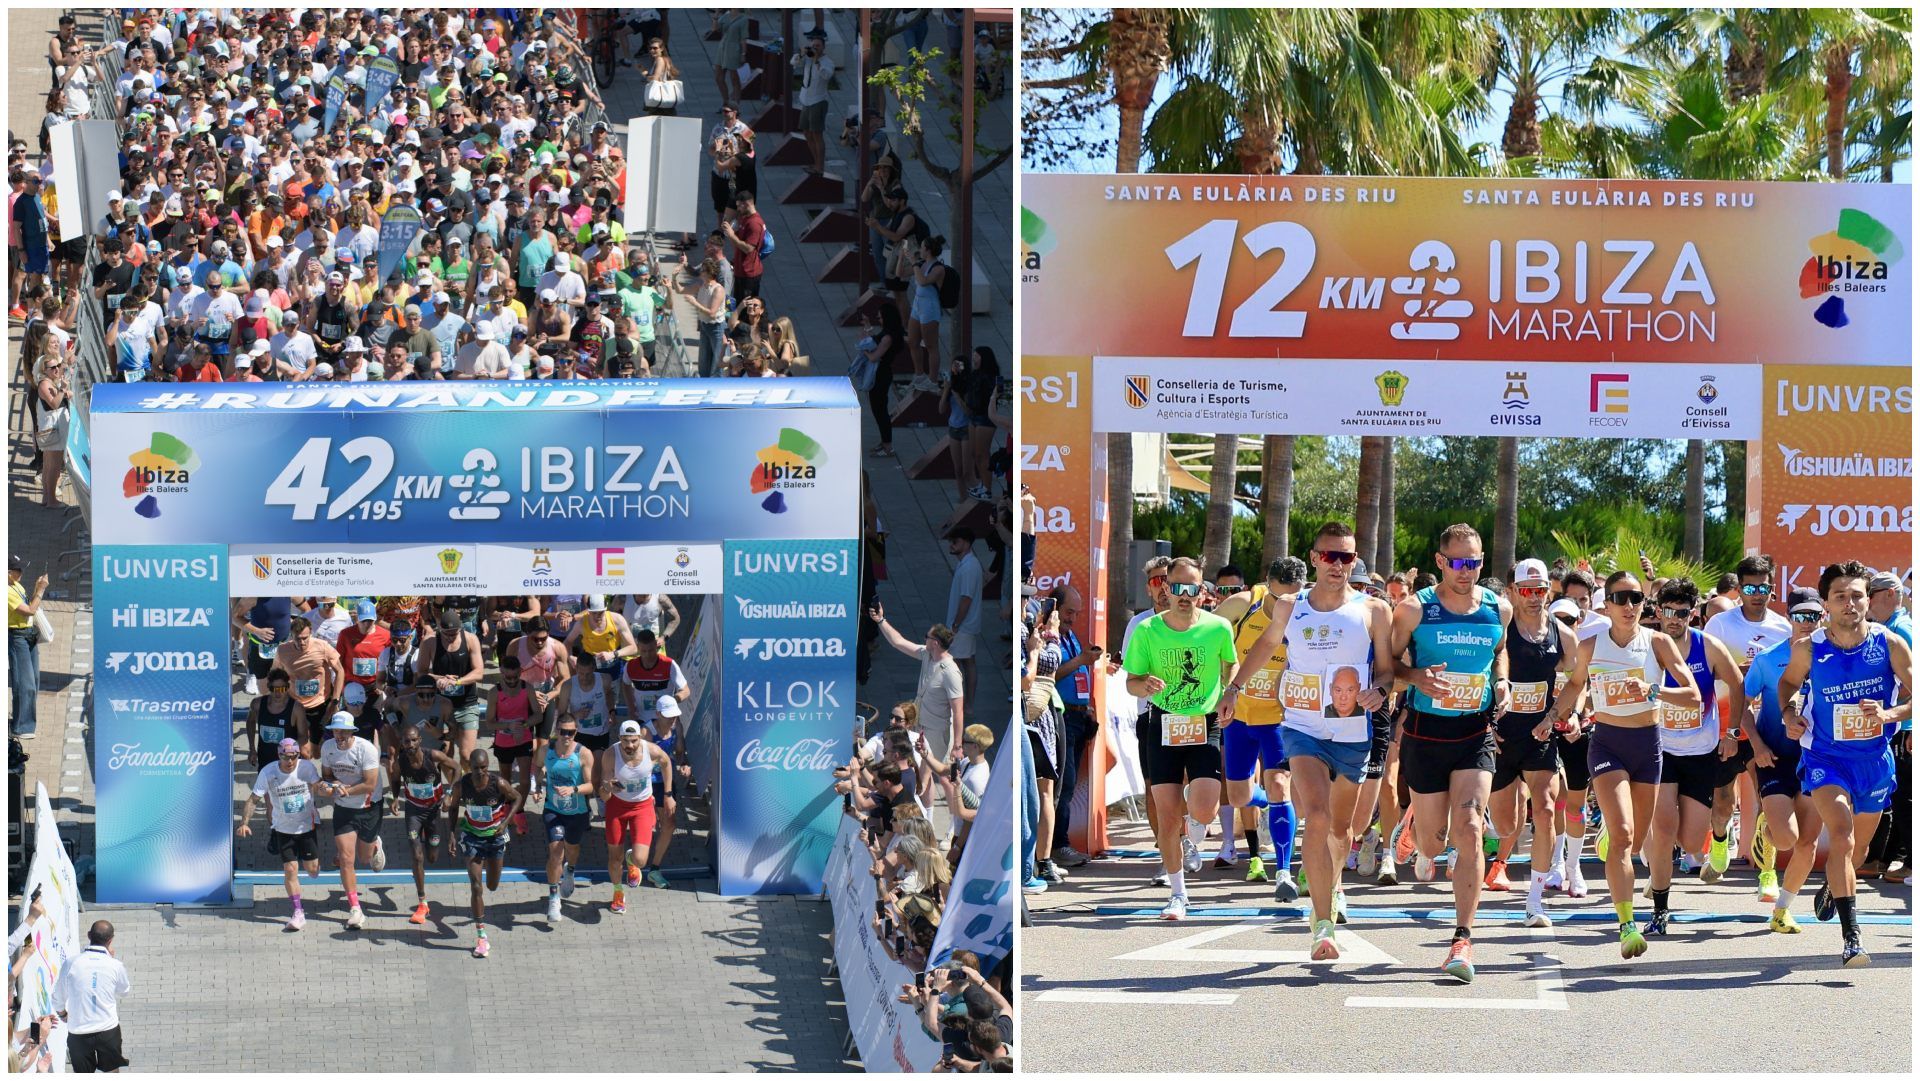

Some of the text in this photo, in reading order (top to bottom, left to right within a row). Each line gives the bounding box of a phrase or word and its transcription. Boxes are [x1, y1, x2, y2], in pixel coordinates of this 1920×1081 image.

[367, 70, 392, 86] 3:45
[1105, 181, 1397, 204] SANTA EULÀRIA DES RIU
[1463, 187, 1755, 208] SANTA EULÀRIA DES RIU
[381, 224, 414, 239] 3:15
[1488, 239, 1717, 306] IBIZA
[1817, 254, 1888, 280] Ibiza
[1164, 219, 1387, 338] 12 KM
[1817, 281, 1887, 293] Illes Balears
[1487, 308, 1717, 343] MARATHON
[1156, 378, 1288, 394] Conselleria de Turisme,
[138, 388, 810, 409] #RUNANDFEEL
[1156, 392, 1197, 405] Cultura
[1208, 394, 1251, 407] Esports
[1686, 405, 1728, 417] Consell
[1341, 418, 1369, 426] SANTA
[1490, 412, 1542, 427] eivissa
[1589, 417, 1629, 427] FECOEV
[1681, 417, 1730, 429] d'Eivissa
[136, 466, 190, 484] Ibiza
[521, 445, 689, 493] IBIZA
[764, 461, 817, 480] Ibiza
[264, 436, 443, 521] 42 KM
[764, 481, 815, 489] Illes Balears
[136, 485, 189, 494] Illes Balears
[521, 494, 690, 519] MARATHON
[103, 554, 219, 582] [UNVRS]
[276, 557, 373, 566] Conselleria de Turisme,
[734, 549, 848, 576] [UNVRS]
[276, 568, 306, 576] Cultura
[314, 568, 346, 577] Esports
[523, 578, 561, 587] eivissa
[664, 578, 701, 586] d'Eivissa
[112, 603, 139, 628] HÏ
[743, 600, 847, 619] USHUAÏA IBIZA
[1436, 630, 1493, 647] Escaladores
[1247, 677, 1276, 691] 506
[1822, 676, 1884, 695] CLUB ATLETISMO
[737, 680, 841, 709] KLOK
[1286, 684, 1319, 701] 5000
[1448, 685, 1482, 700] 5020
[1514, 691, 1545, 704] 5067
[130, 696, 216, 713] Trasmed
[745, 711, 834, 722] LONGEVITY
[1665, 709, 1699, 722] 5006
[1171, 723, 1203, 737] 5015
[108, 742, 217, 777] Fandango
